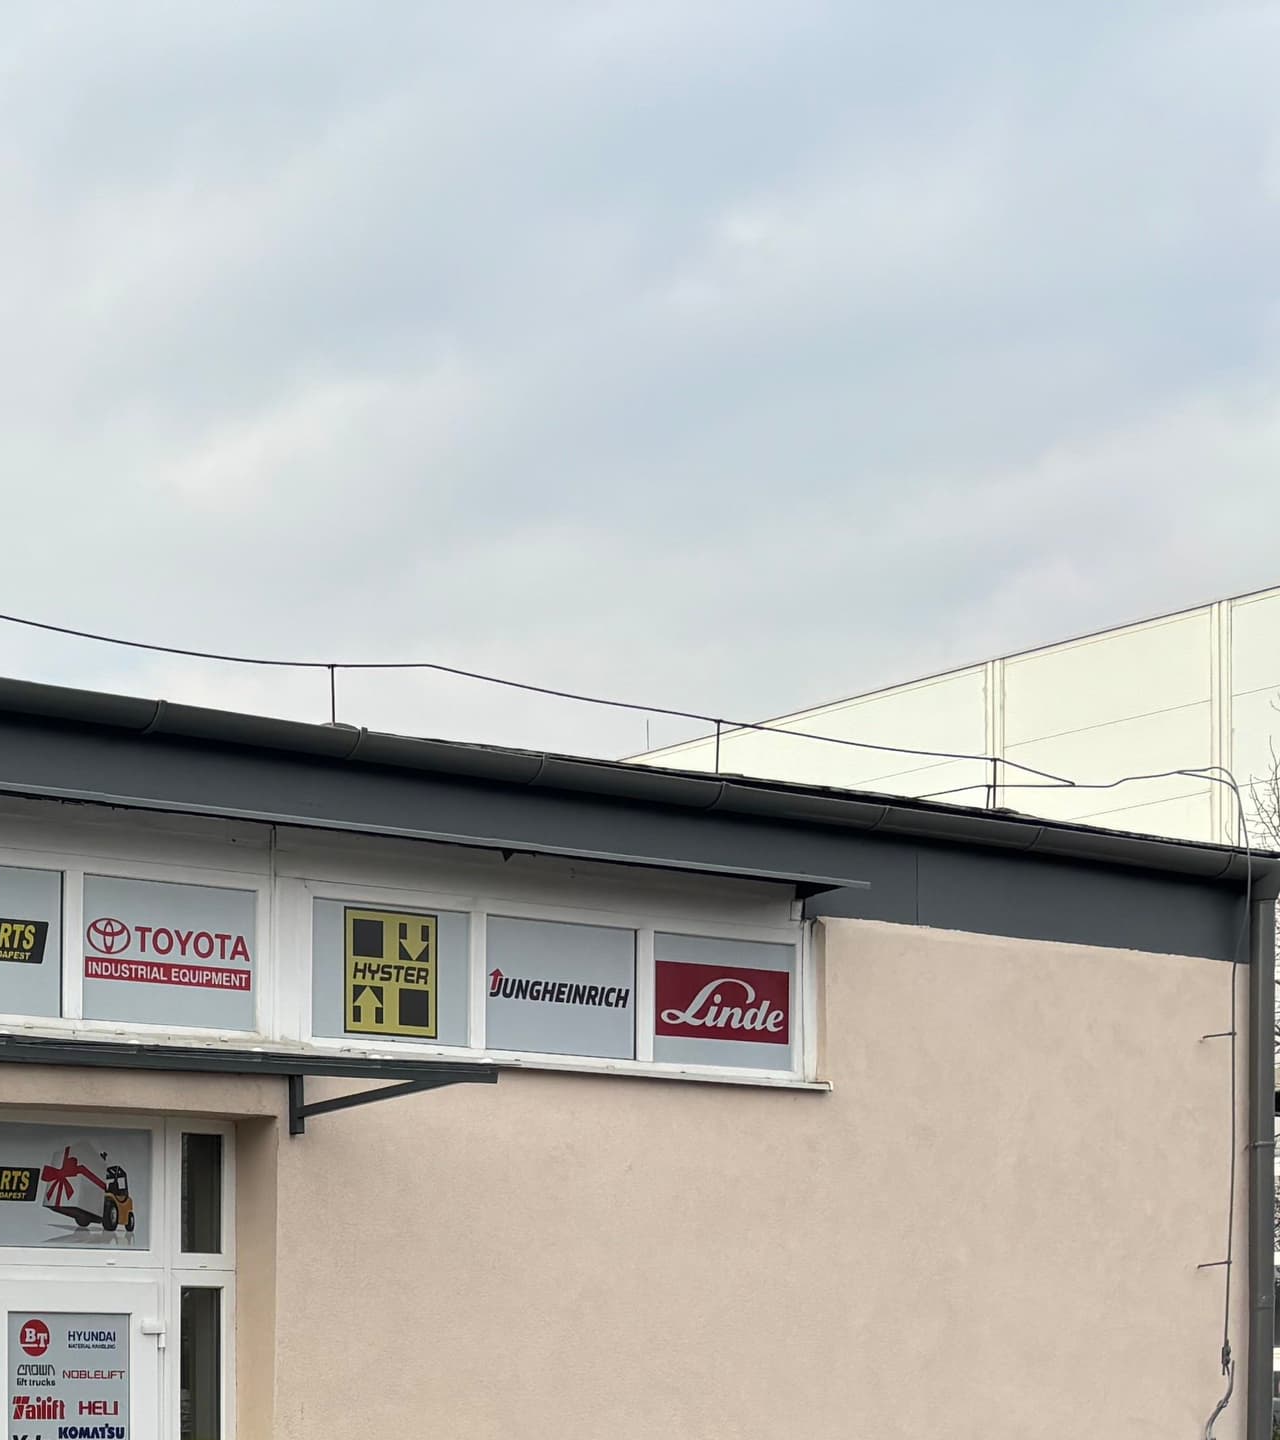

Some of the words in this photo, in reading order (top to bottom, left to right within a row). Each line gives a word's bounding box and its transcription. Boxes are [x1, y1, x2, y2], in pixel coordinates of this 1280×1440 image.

[134, 926, 251, 962] TOYOTA
[87, 962, 168, 982] INDUSTRIAL
[170, 967, 248, 988] EQUIPMENT
[353, 961, 430, 985] HYSTER
[489, 976, 630, 1009] JUNGHEINRICH
[660, 978, 784, 1033] Linde
[25, 1328, 47, 1347] BT
[68, 1331, 116, 1342] HYUNDAI
[16, 1378, 28, 1386] lift
[29, 1378, 56, 1387] trucks
[62, 1370, 125, 1380] NOBLELIFT
[13, 1396, 65, 1420] Tailift
[78, 1401, 119, 1415] HELI
[58, 1423, 125, 1439] KOMATSU
